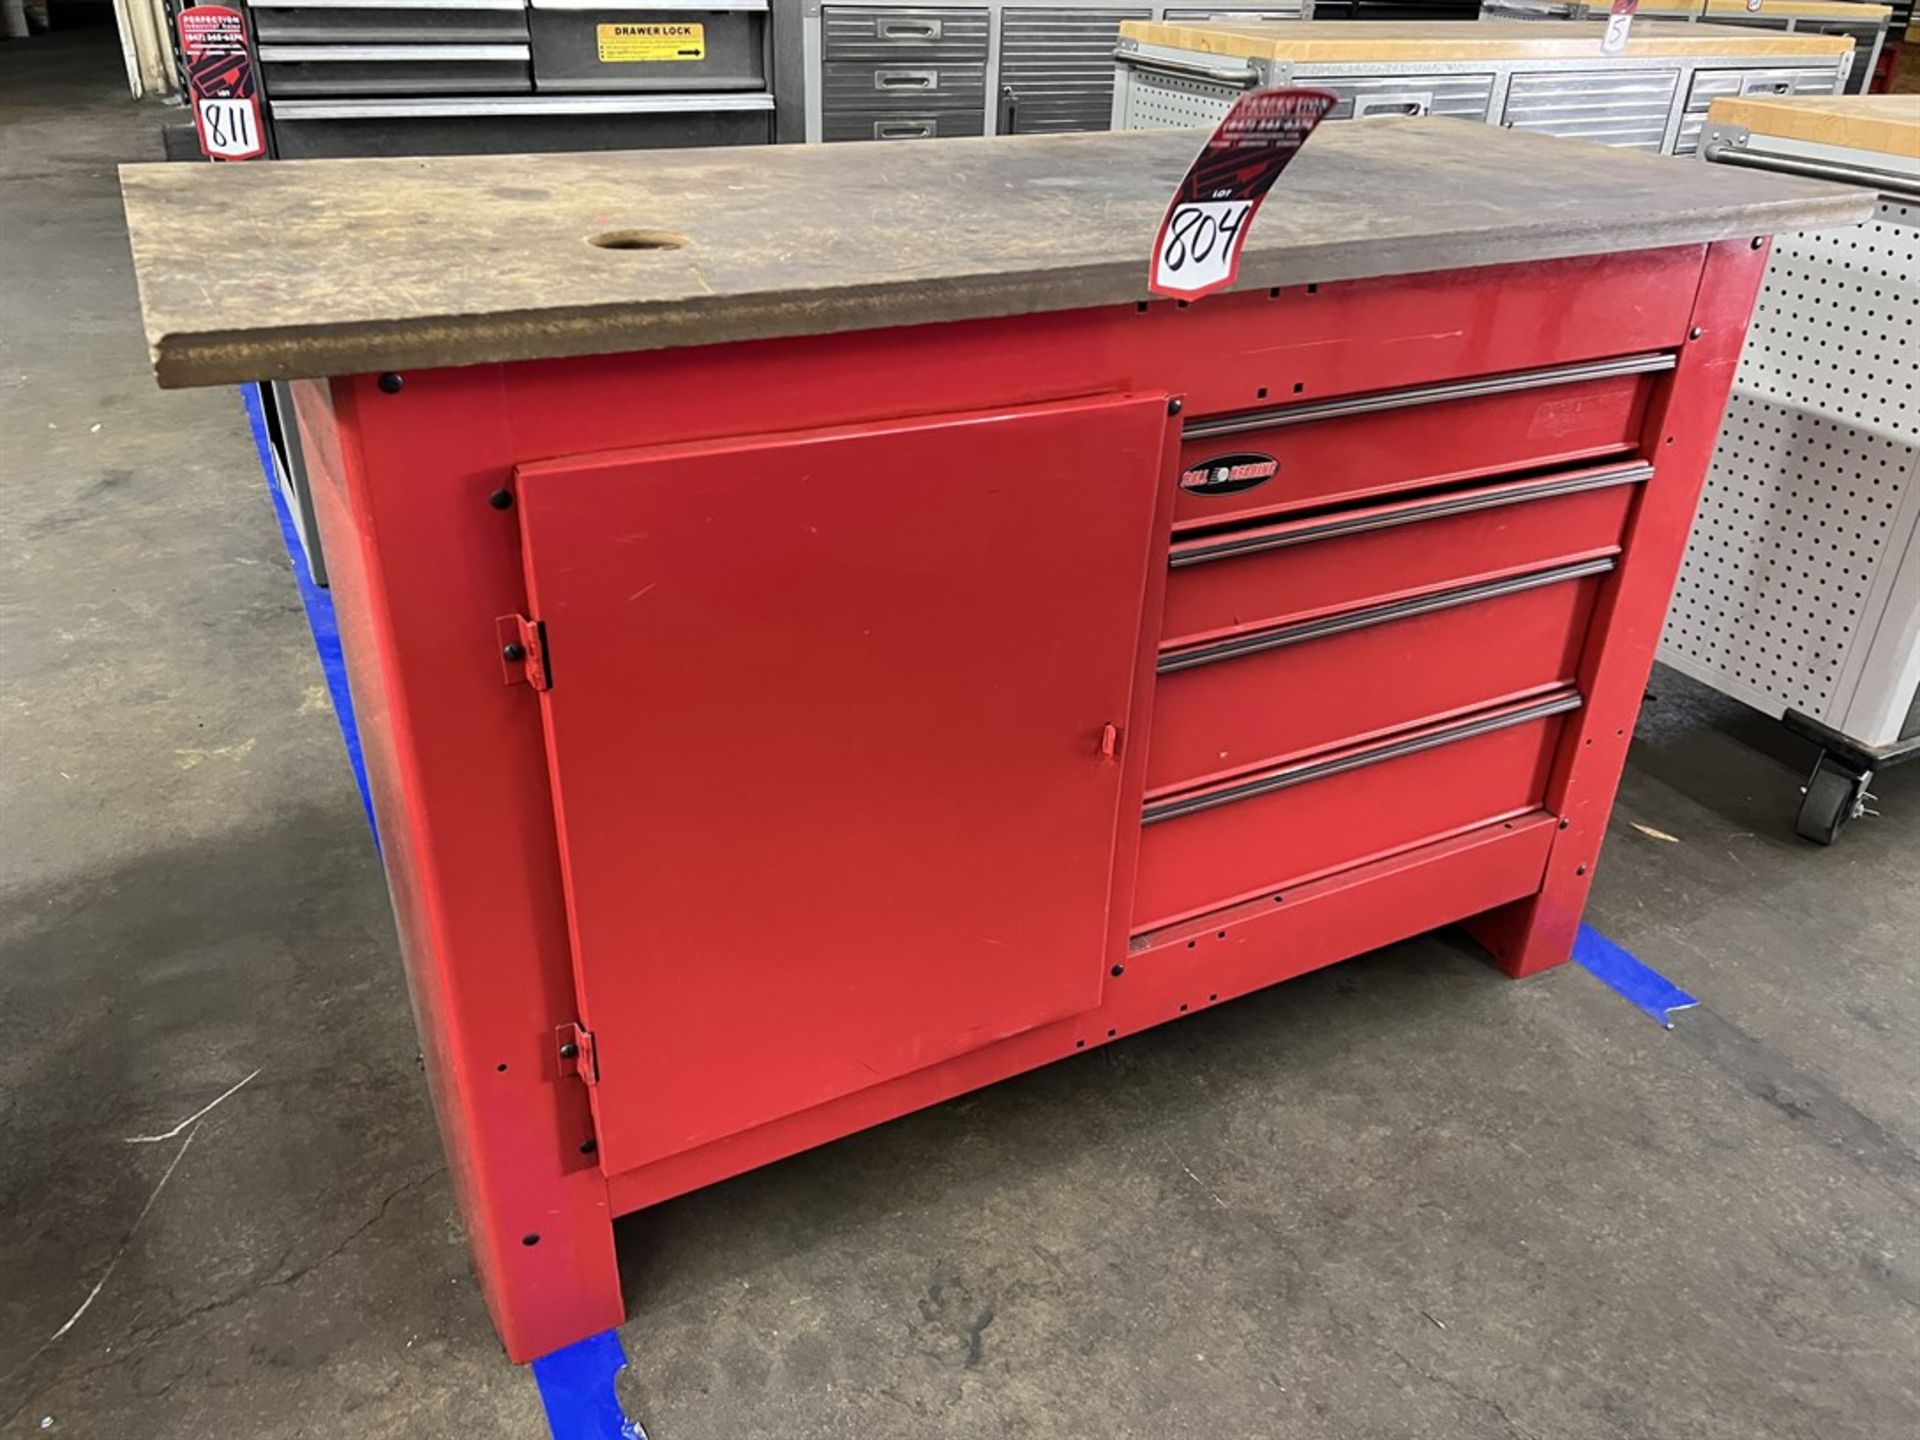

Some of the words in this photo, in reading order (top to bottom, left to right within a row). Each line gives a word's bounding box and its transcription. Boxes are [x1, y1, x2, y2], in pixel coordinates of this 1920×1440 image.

[183, 16, 240, 24] PERFECTION
[615, 27, 660, 35] DRAWER
[663, 26, 691, 35] LOCK
[205, 103, 248, 147] 811
[1212, 188, 1232, 198] LOT
[1164, 204, 1250, 272] 804
